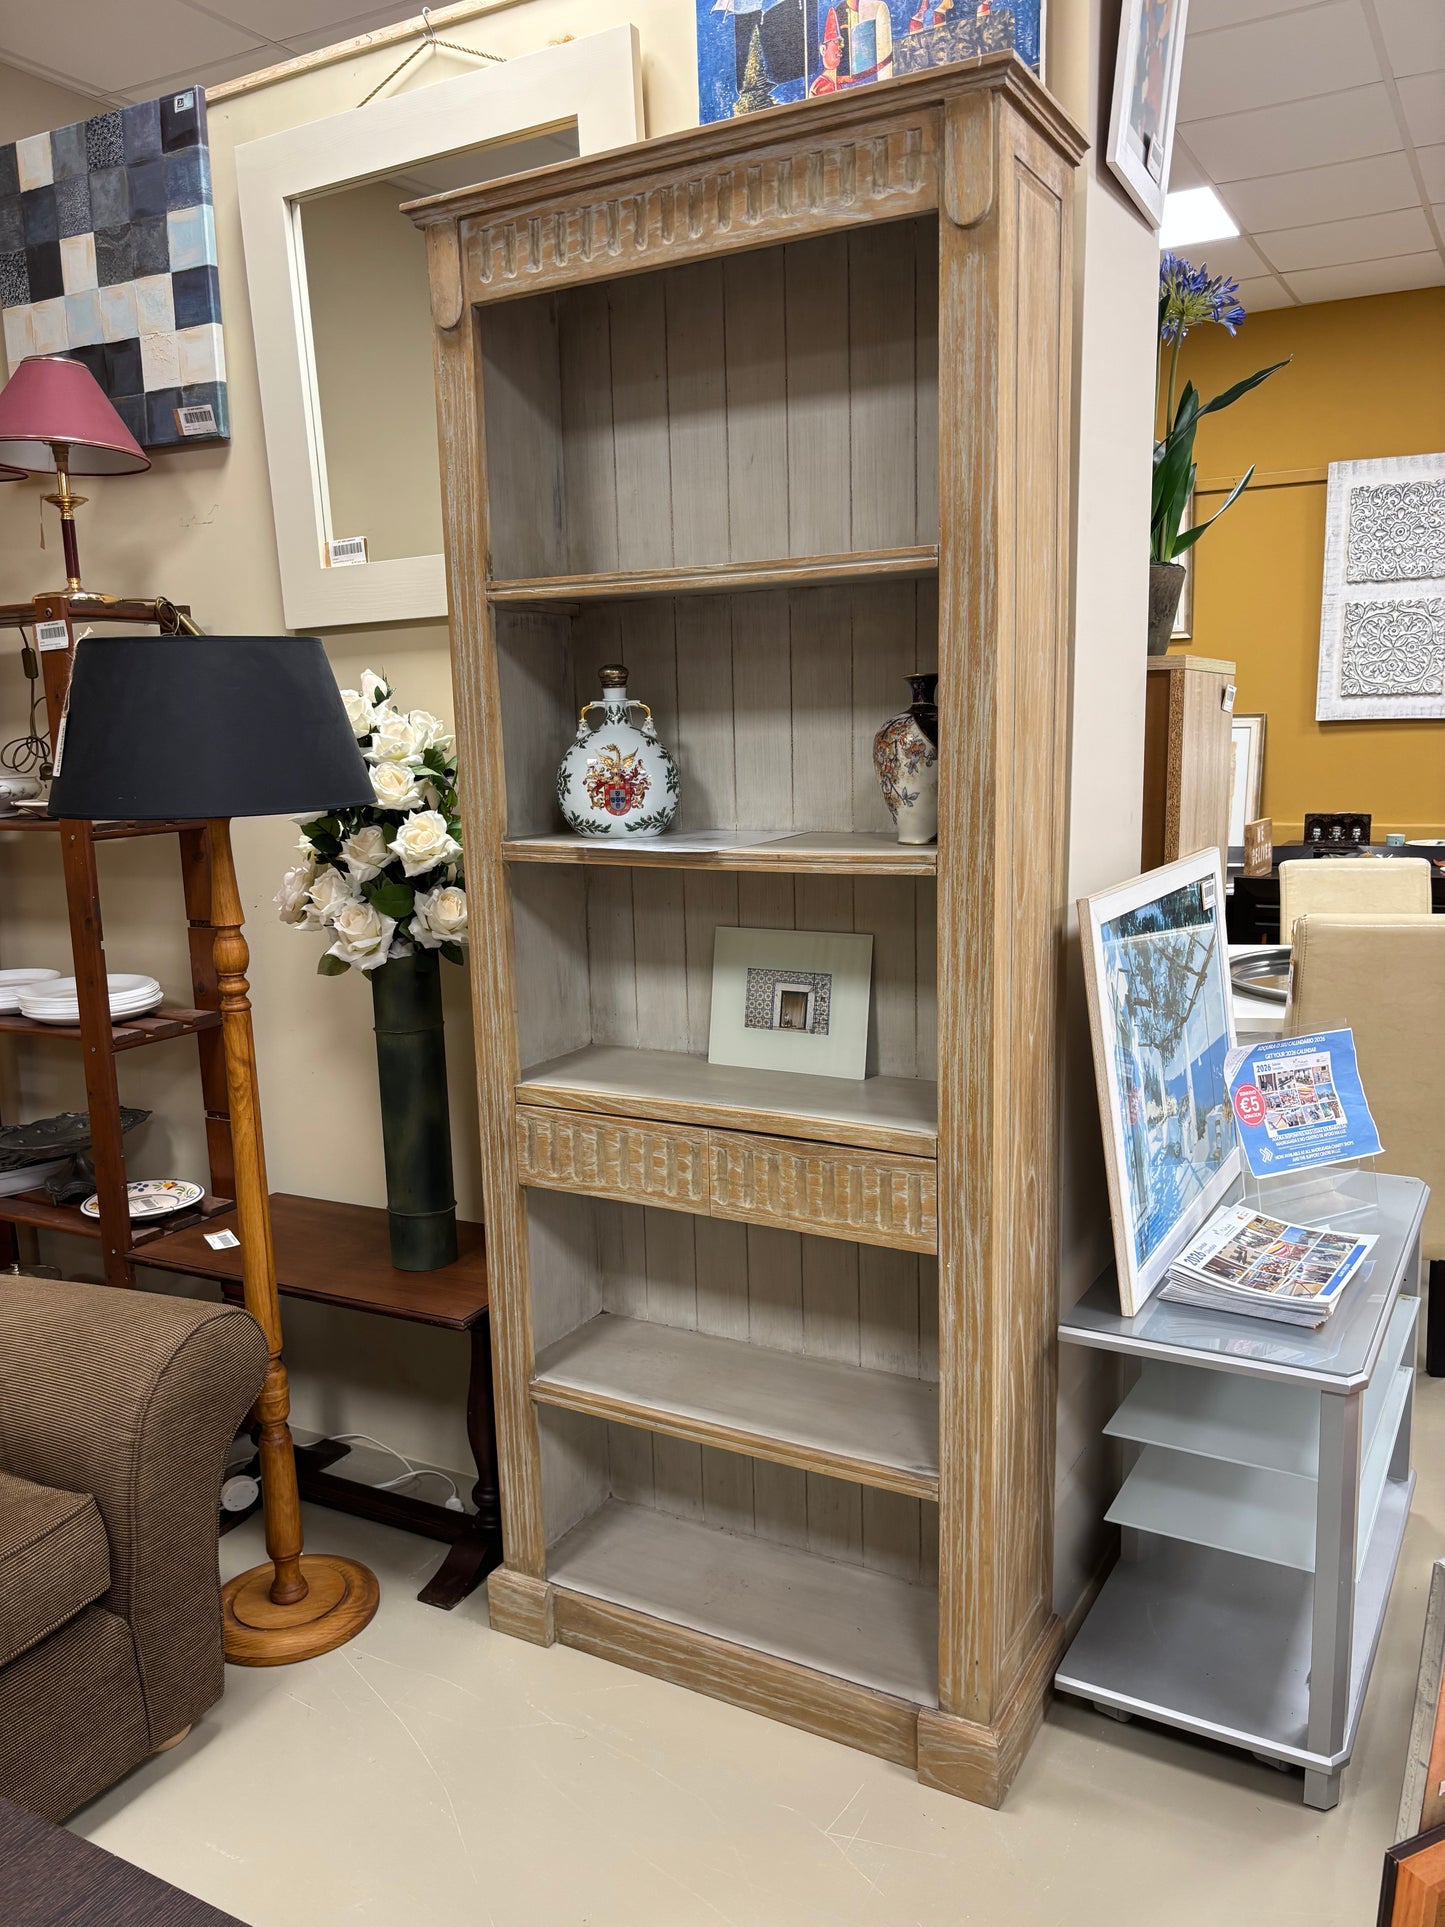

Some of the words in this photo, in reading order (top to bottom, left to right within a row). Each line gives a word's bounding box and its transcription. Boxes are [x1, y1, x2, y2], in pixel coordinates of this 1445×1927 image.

[1314, 1036, 1326, 1044] 2026
[1273, 1051, 1285, 1059] YOUR
[1285, 1050, 1296, 1058] 2026
[1296, 1047, 1317, 1056] CALENDAR
[1256, 1063, 1272, 1073] 2026
[1240, 1095, 1260, 1113] €5
[1183, 1250, 1206, 1266] 2026
